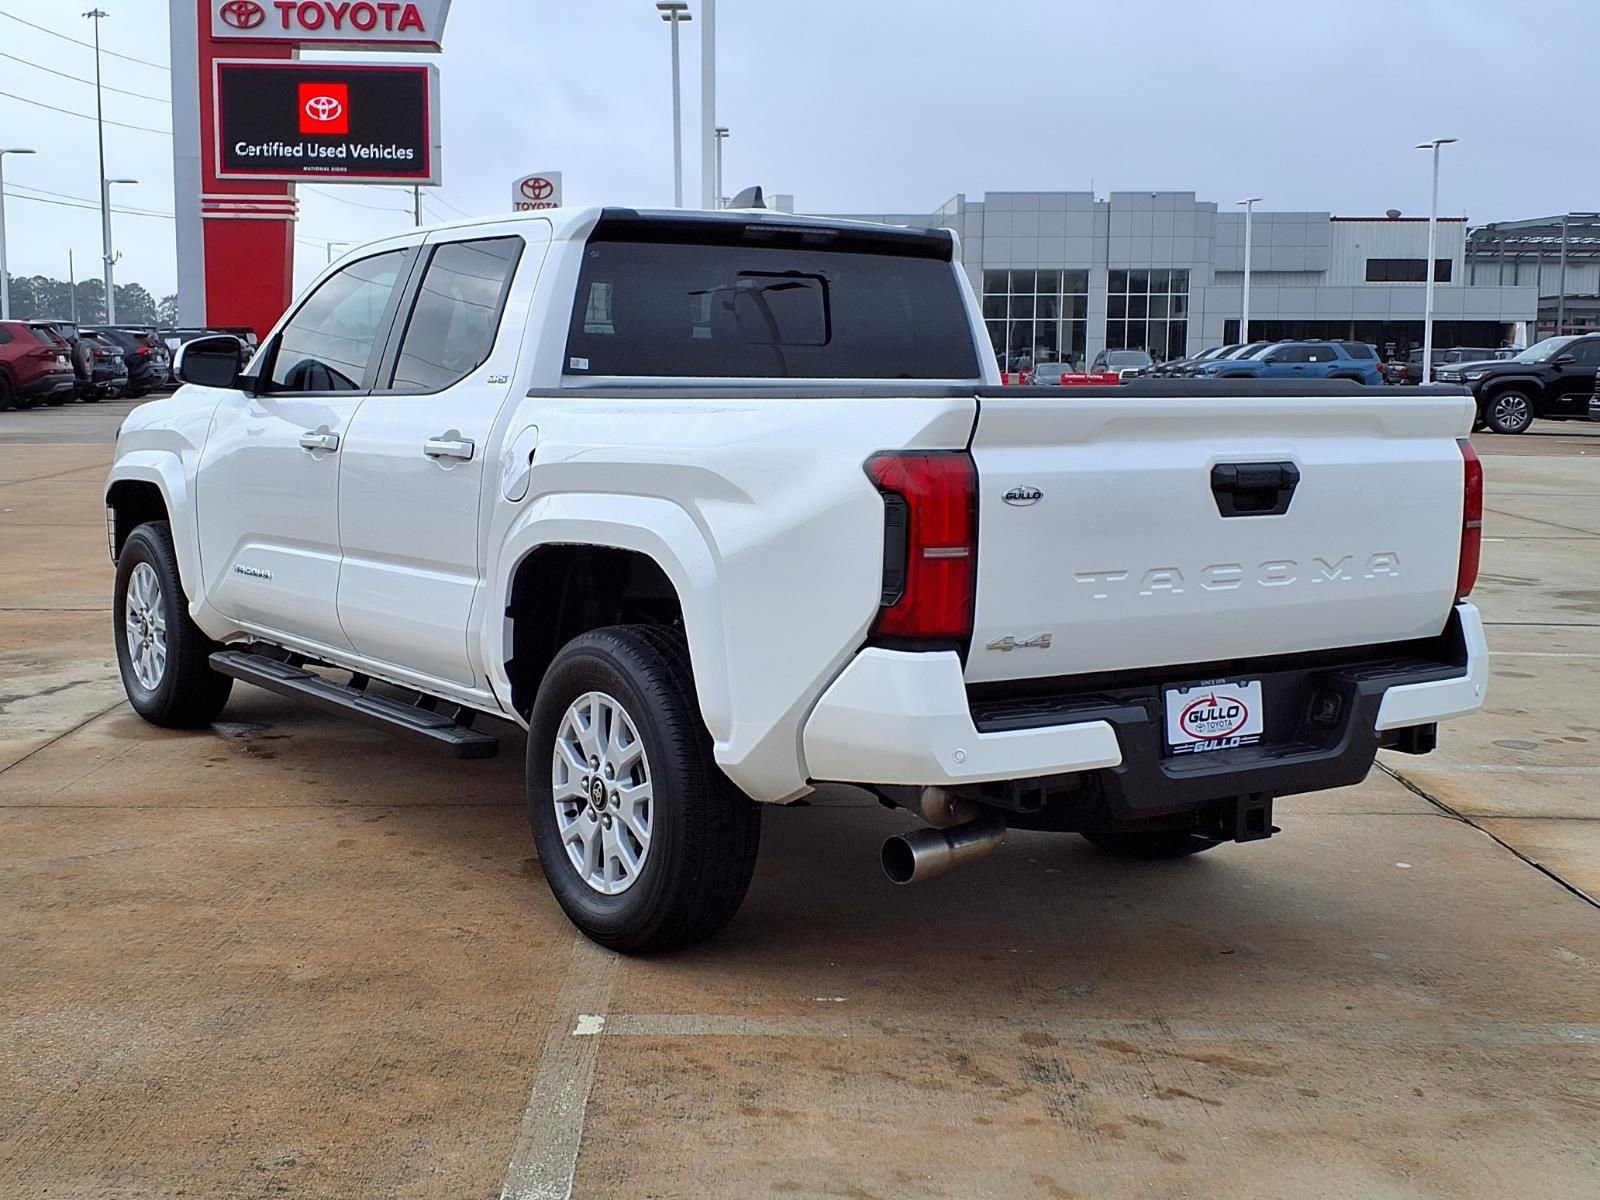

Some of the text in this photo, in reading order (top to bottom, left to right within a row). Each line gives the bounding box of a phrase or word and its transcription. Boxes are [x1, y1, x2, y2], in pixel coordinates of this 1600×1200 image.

[273, 1, 425, 32] TOYOTA
[235, 141, 414, 160] Certified Used Vehicles
[514, 202, 559, 211] TOYOTA
[1005, 491, 1042, 500] GULLO
[1074, 552, 1400, 599] TACOMA
[1189, 706, 1239, 723] GULLO
[1206, 720, 1232, 728] TOYOTA
[1194, 737, 1240, 752] GULLO
